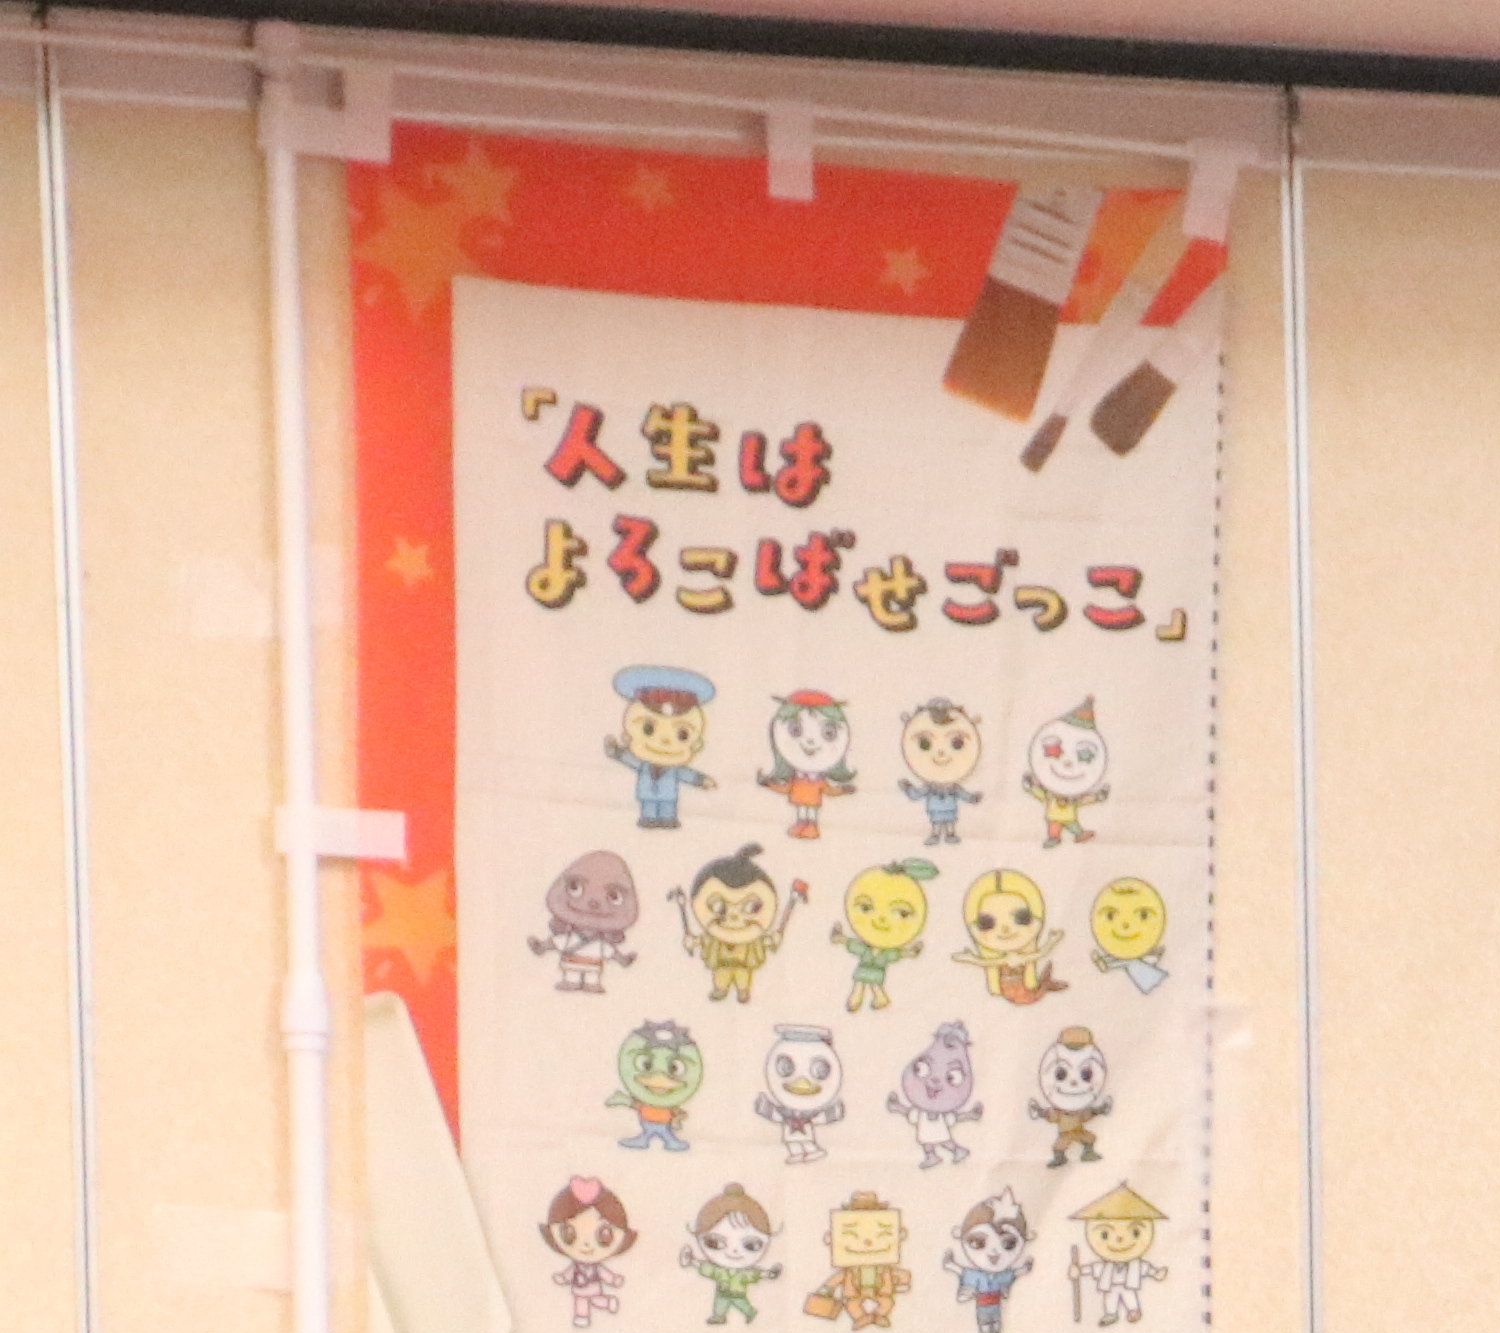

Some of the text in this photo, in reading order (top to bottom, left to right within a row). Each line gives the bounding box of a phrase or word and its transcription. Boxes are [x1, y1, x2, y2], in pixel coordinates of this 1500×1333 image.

[520, 386, 832, 506] 「人生は
[525, 515, 1187, 642] よろこばせごっこ」
